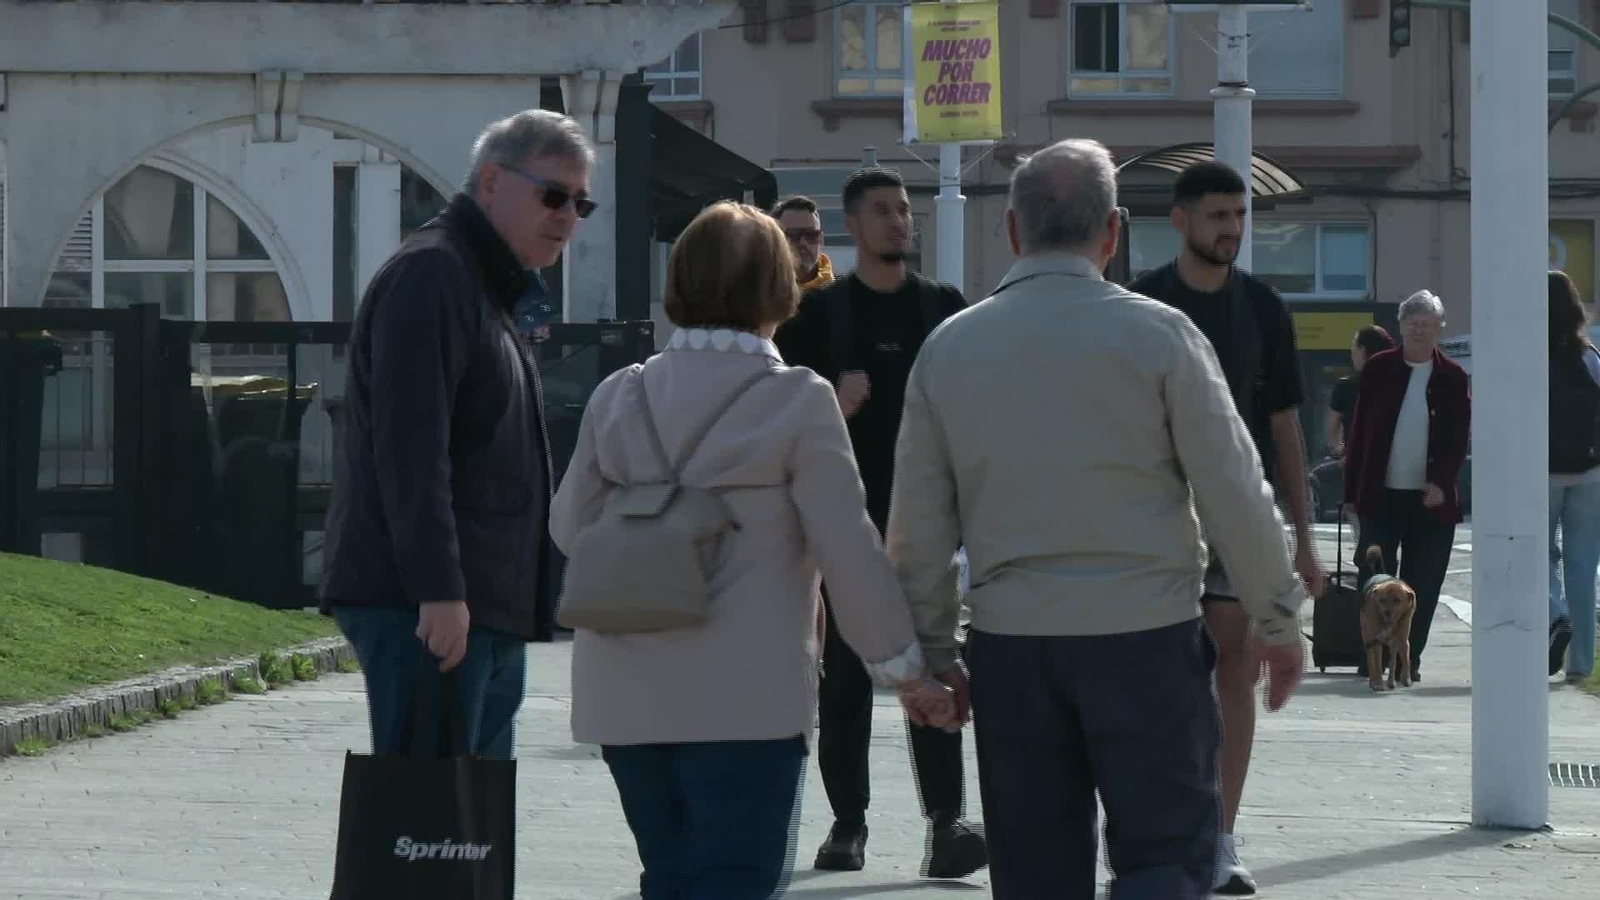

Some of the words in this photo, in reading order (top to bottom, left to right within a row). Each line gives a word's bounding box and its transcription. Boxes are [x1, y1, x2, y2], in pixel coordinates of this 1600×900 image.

[921, 38, 991, 62] MUCHO
[938, 60, 974, 83] POR
[923, 82, 991, 107] CORRER
[394, 836, 491, 861] Sprinter
